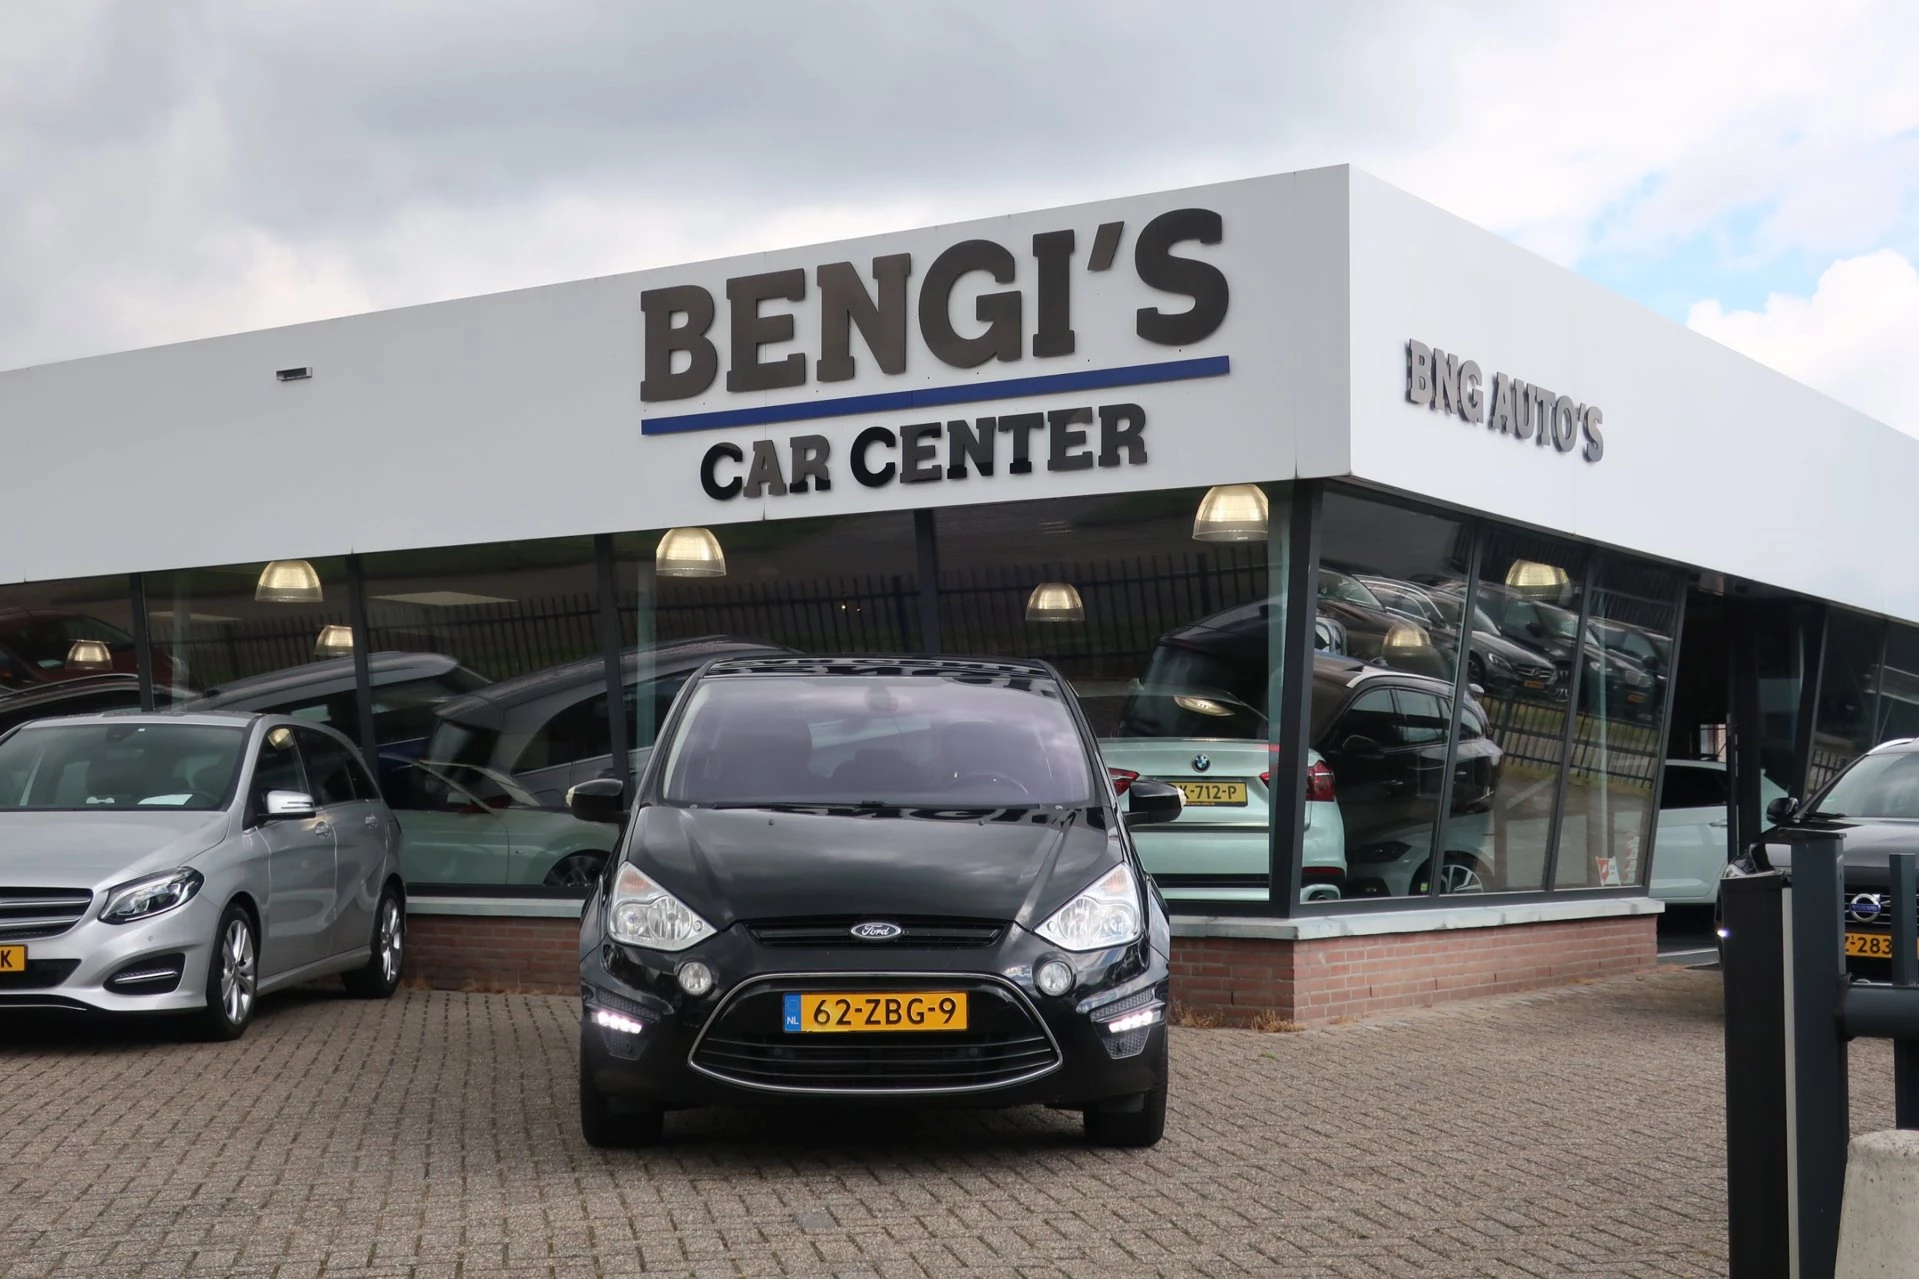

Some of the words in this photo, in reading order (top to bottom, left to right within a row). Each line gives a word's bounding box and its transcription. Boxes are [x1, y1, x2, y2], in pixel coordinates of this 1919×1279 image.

[640, 207, 1229, 402] BENGI'S
[1406, 338, 1484, 423] BNG
[1488, 371, 1604, 462] AUTO'S
[700, 434, 831, 501] CAR
[850, 403, 1148, 488] CENTER
[861, 924, 889, 936] Ford
[1, 950, 13, 968] K
[787, 1016, 799, 1025] NL
[813, 997, 957, 1026] 62-ZBG-9
